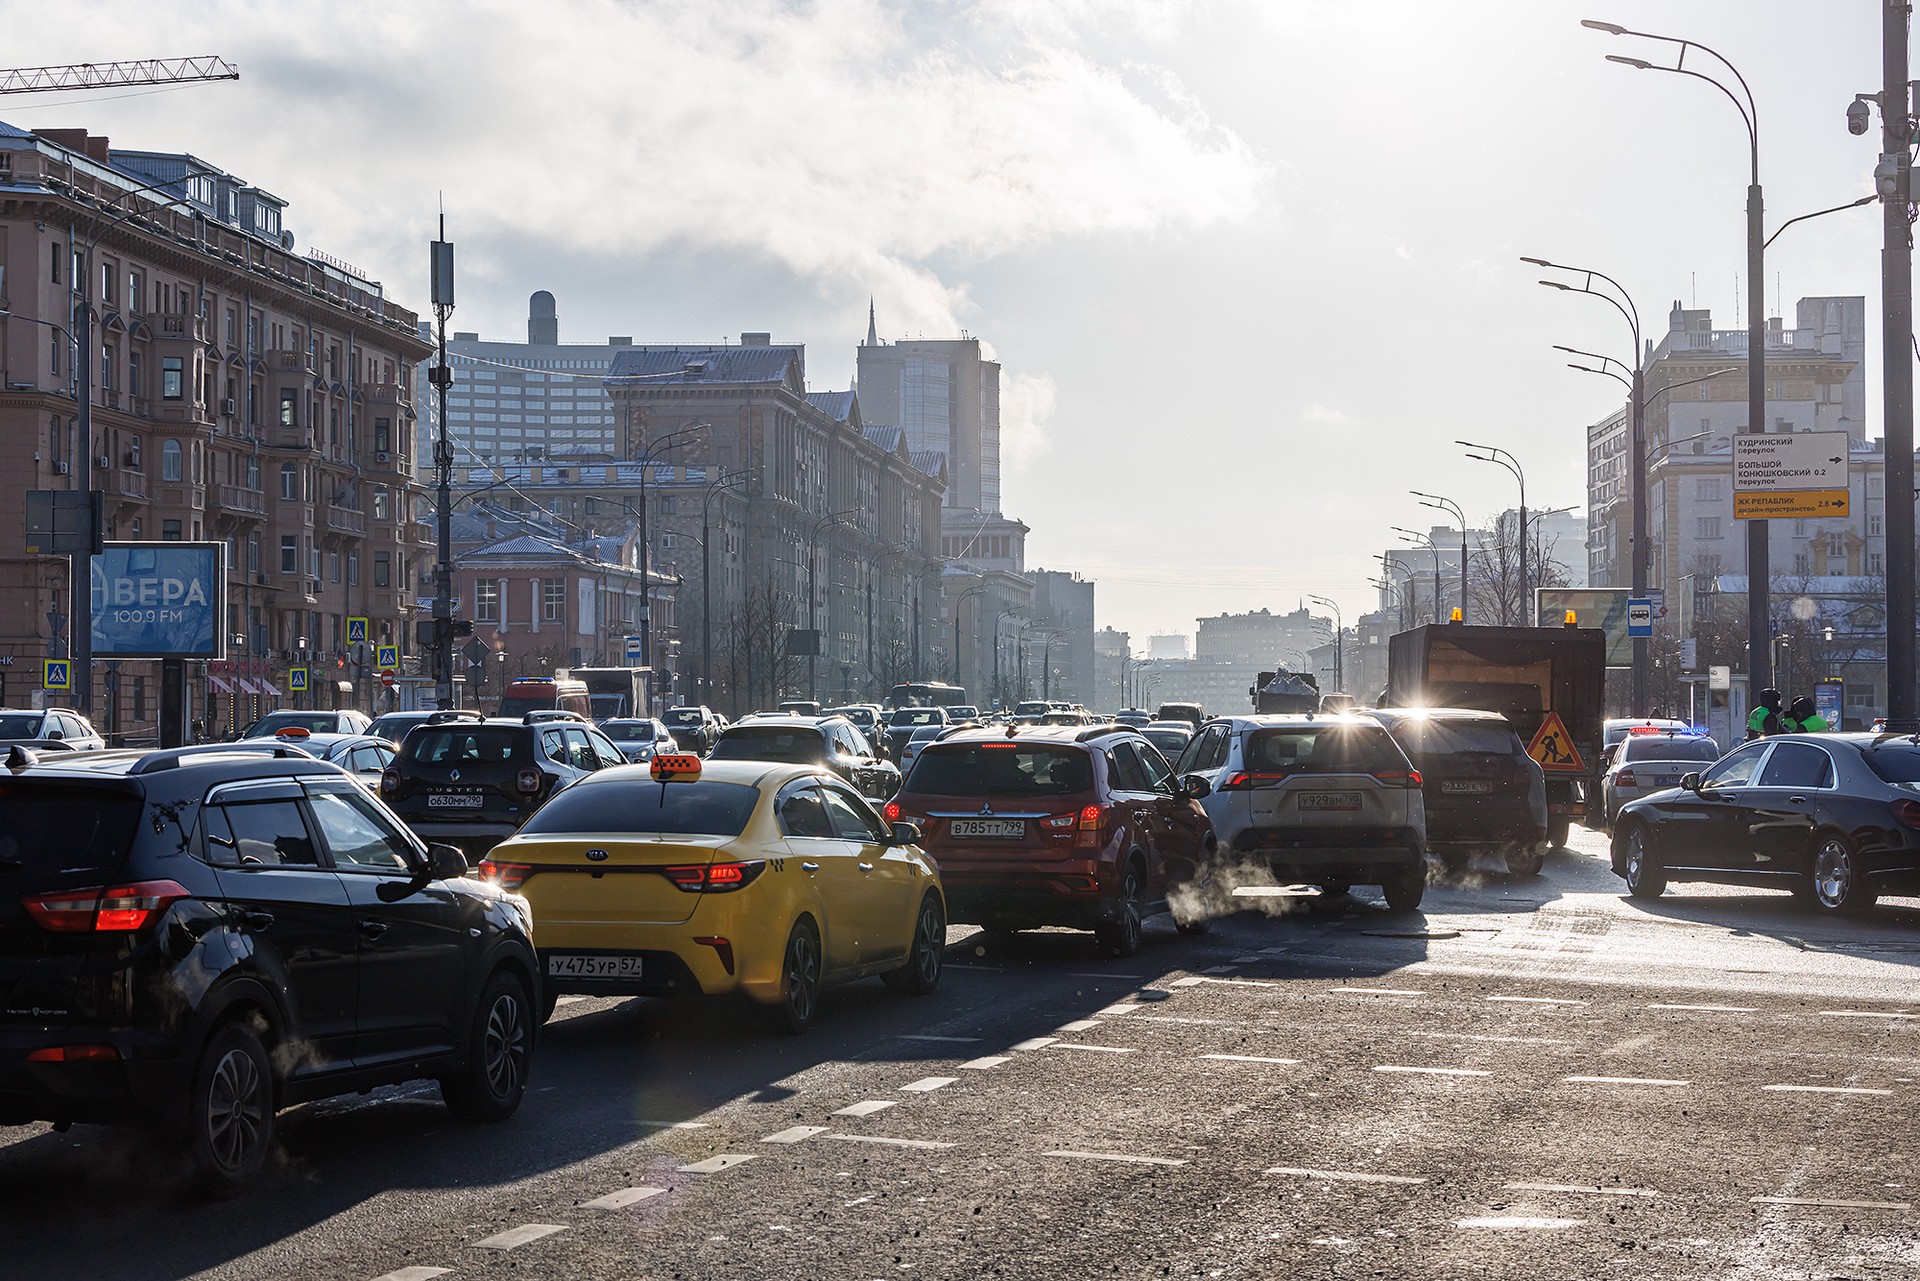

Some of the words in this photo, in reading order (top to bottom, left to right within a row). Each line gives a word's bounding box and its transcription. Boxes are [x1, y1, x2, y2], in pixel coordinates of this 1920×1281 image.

[1738, 437, 1793, 447] КУДРИНСКИЙ
[1738, 460, 1782, 469] БОЛЬШОЙ
[1738, 468, 1811, 478] КОНЮШКОВСКИЙ
[114, 578, 207, 606] ВЕРА
[114, 610, 156, 623] 100.9
[160, 610, 183, 623] FM
[588, 851, 605, 860] KIA
